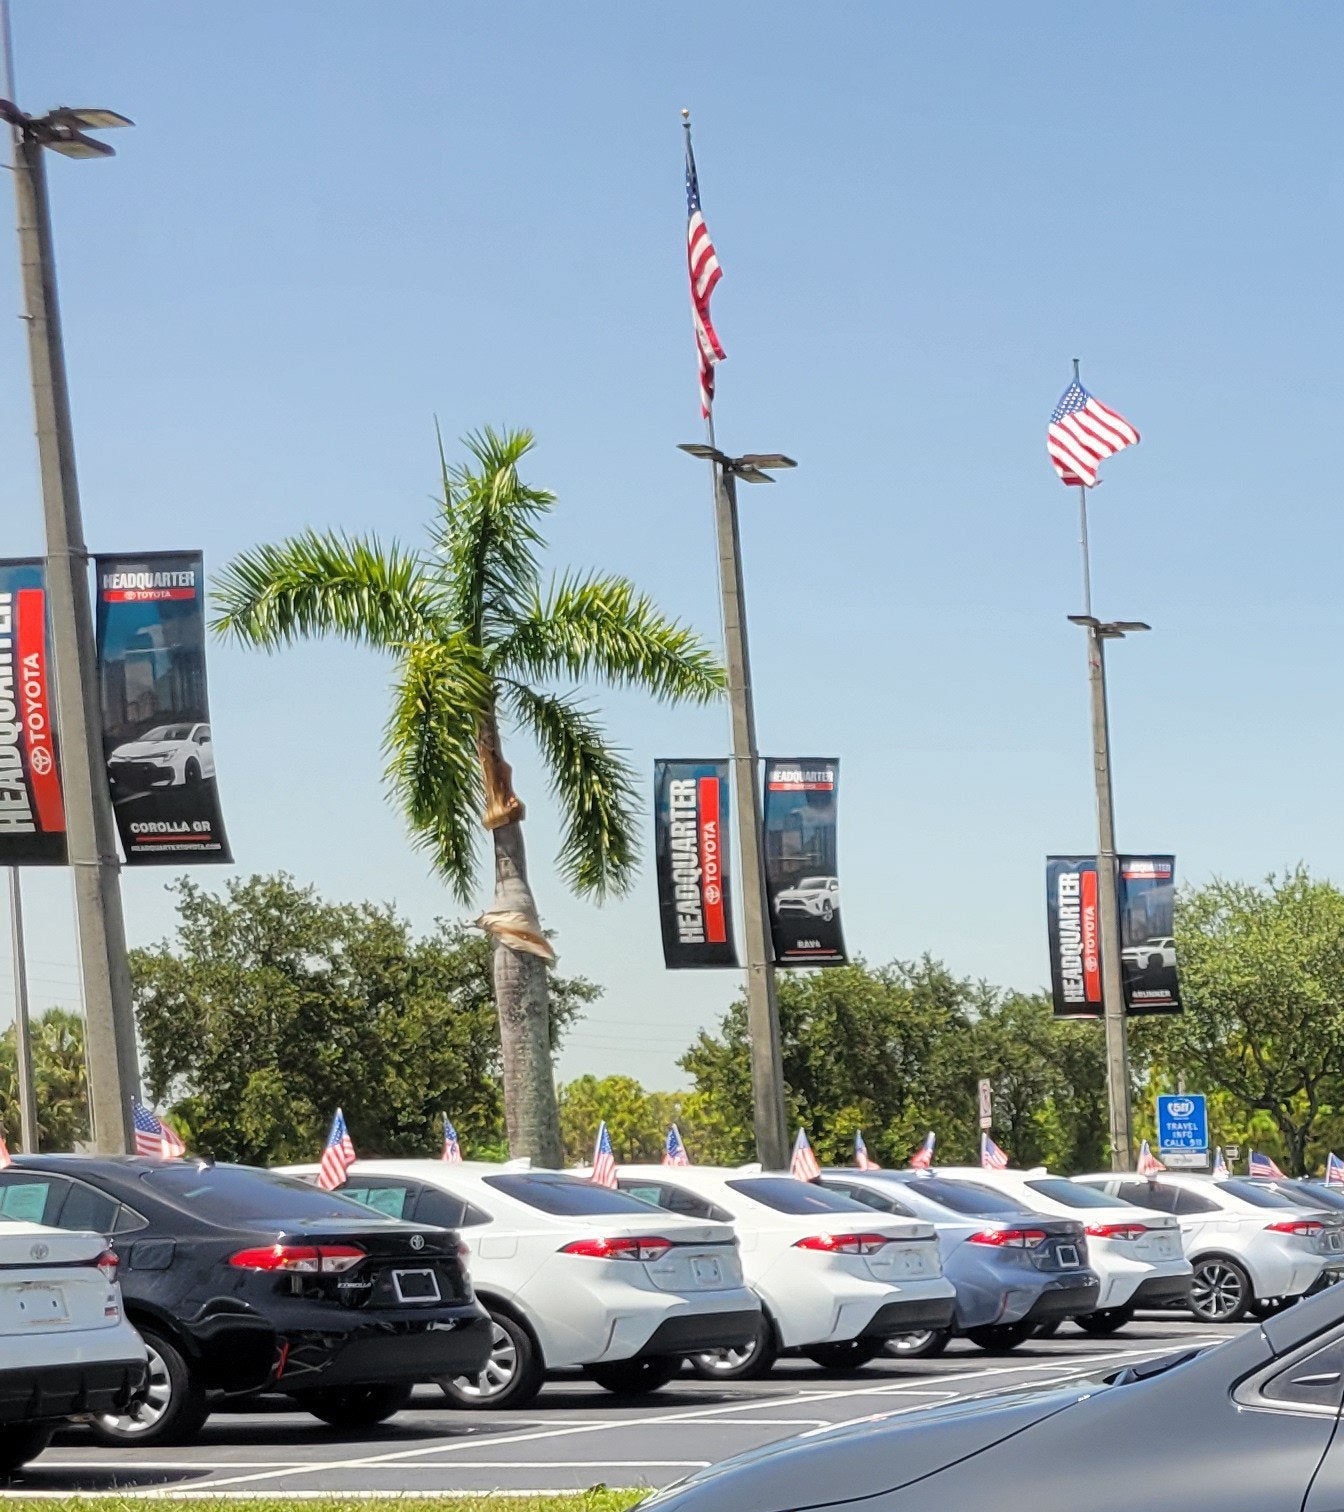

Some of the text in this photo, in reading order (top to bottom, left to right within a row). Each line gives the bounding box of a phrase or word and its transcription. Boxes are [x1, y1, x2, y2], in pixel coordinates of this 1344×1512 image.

[103, 570, 195, 590] HEADQUARTER
[136, 590, 172, 600] TOYOTA
[23, 652, 46, 744] TOYOTA
[130, 820, 212, 834] COROLLA GR
[669, 778, 706, 944] HEADQUARTER
[704, 820, 718, 884] TOYOTA
[1058, 872, 1086, 1003] HEADQUARTER
[1083, 905, 1096, 954] TOYOTA
[1163, 1138, 1185, 1147] CALL
[1166, 1122, 1199, 1131] TRAVEL
